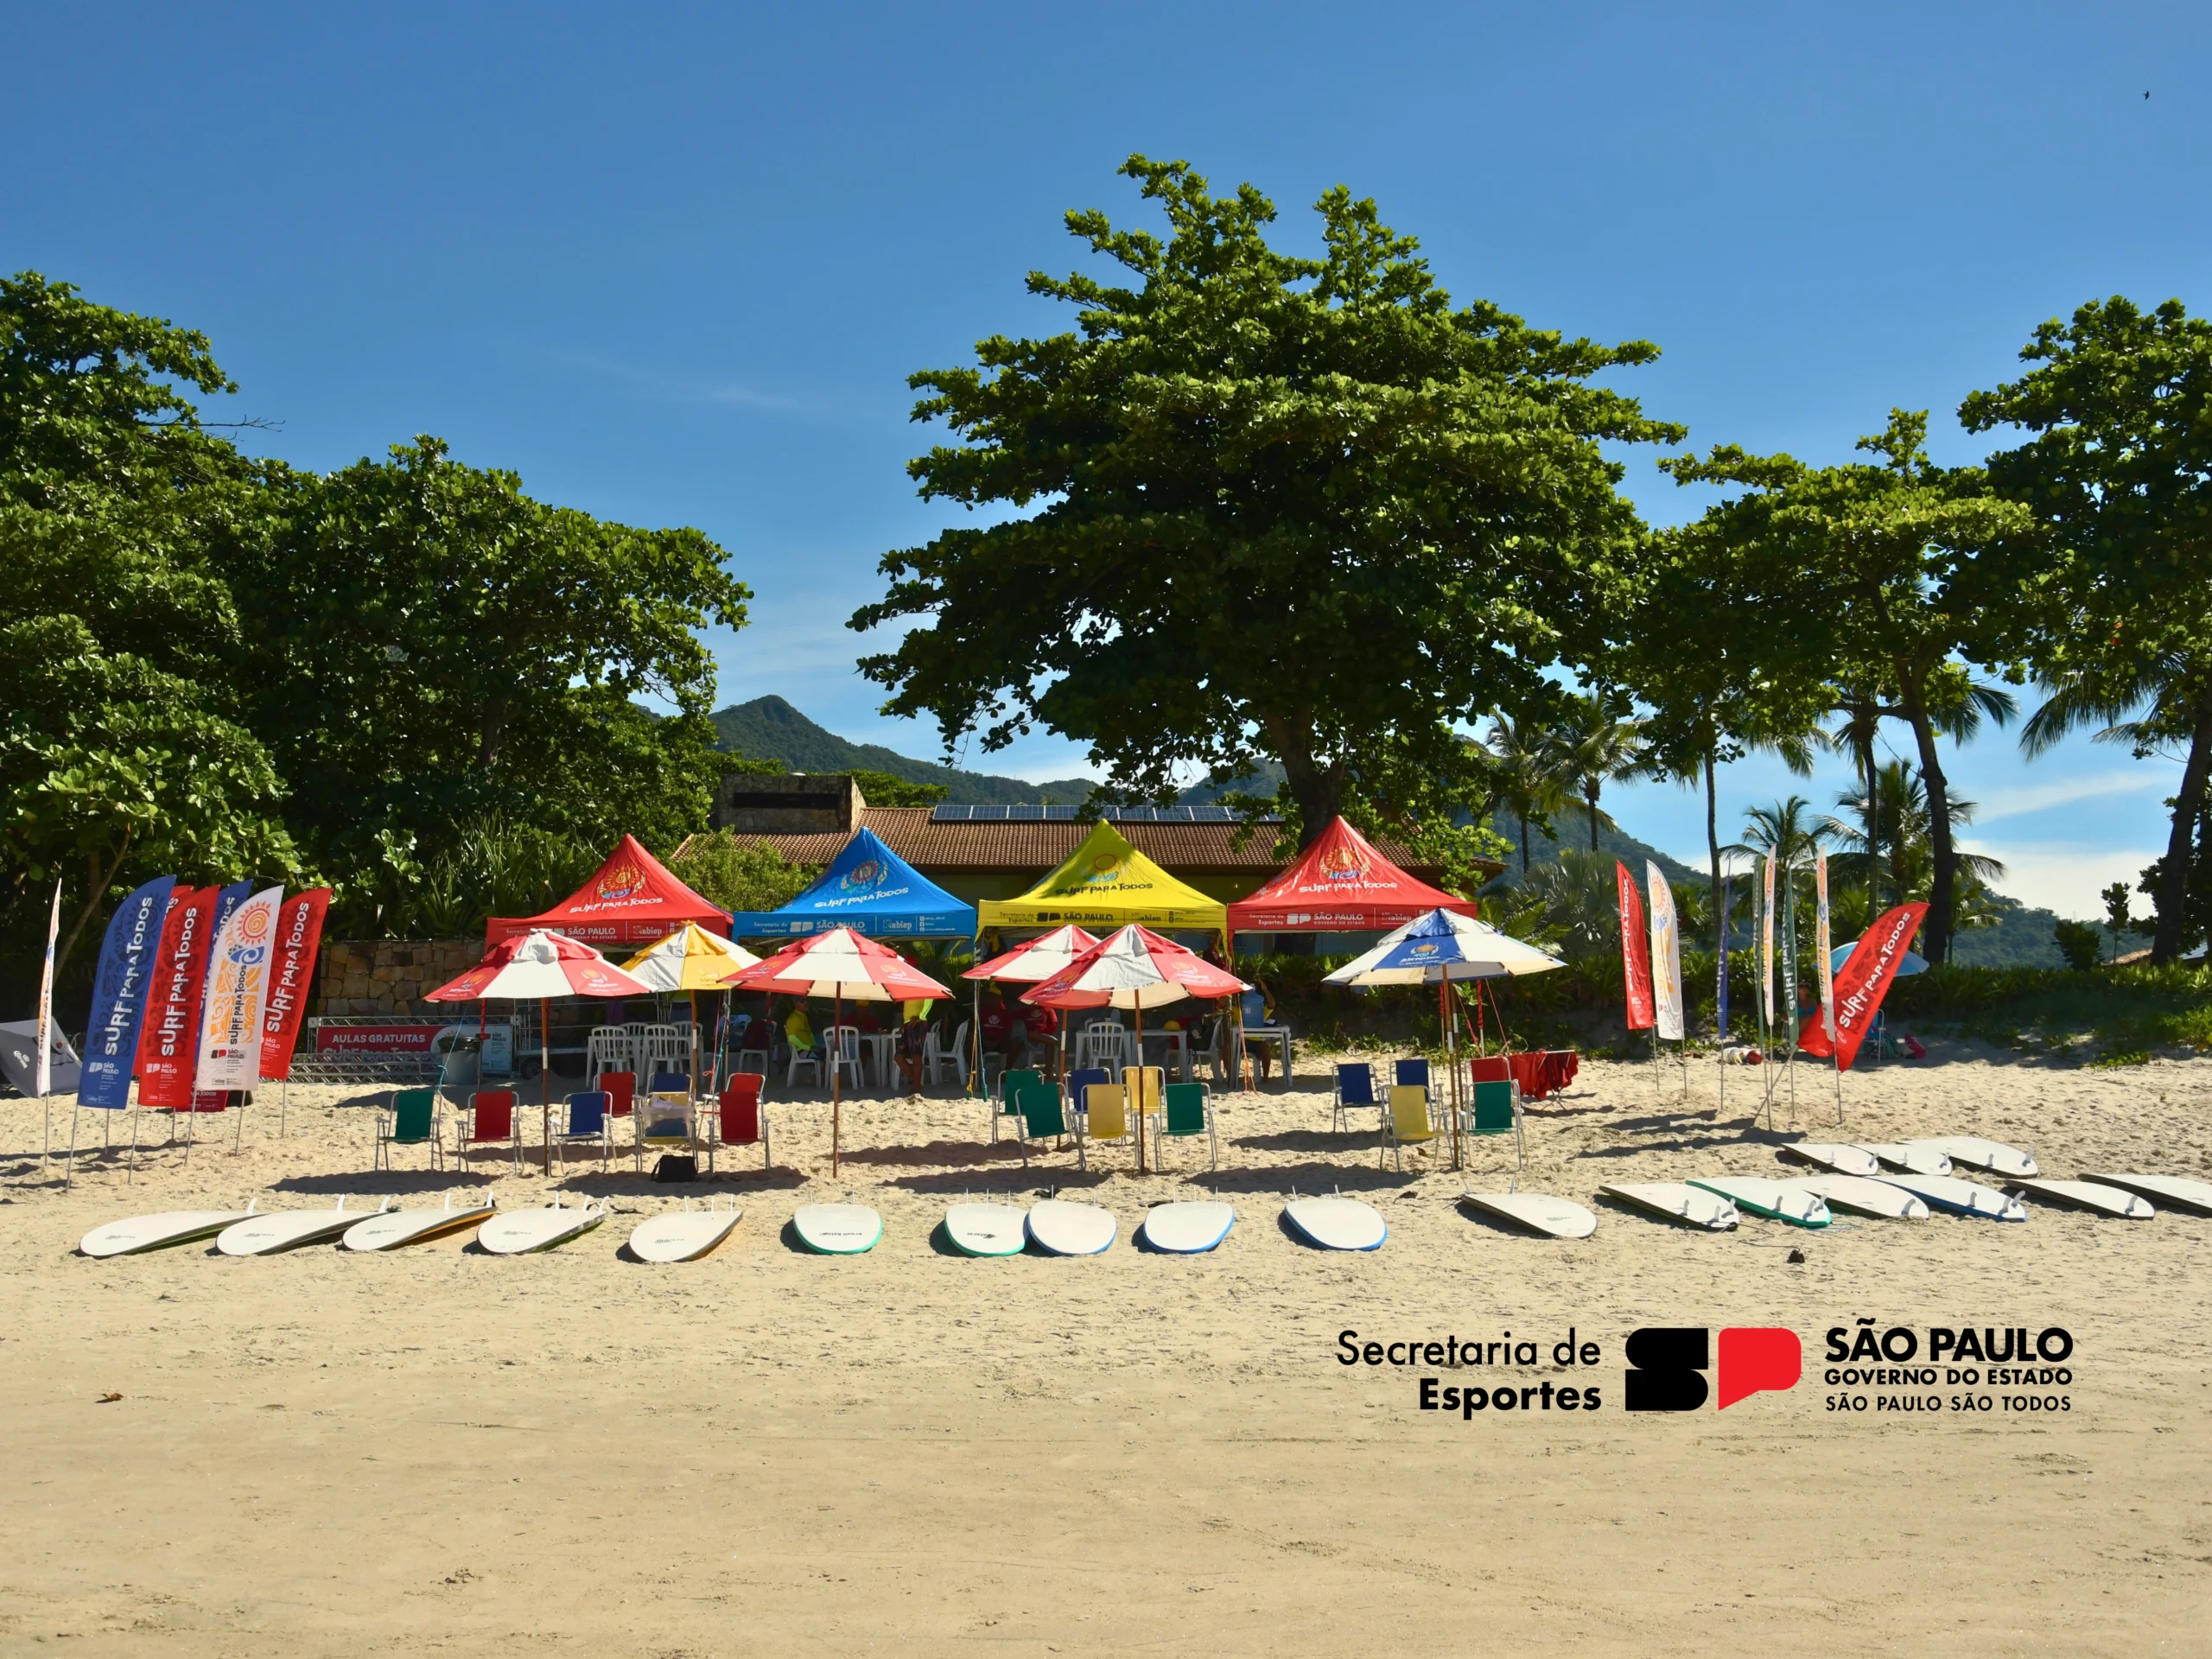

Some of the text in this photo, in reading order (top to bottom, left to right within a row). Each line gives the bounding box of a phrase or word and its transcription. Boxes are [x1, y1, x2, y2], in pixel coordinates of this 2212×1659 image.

[814, 887, 909, 908] SURF PARA TODOS
[1055, 882, 1154, 895] SURF PARA TODOS
[1299, 880, 1398, 893] SURF PARA TODOS
[569, 897, 663, 913] SURF PARA TODOS
[1064, 911, 1083, 920] SÃO
[1313, 912, 1332, 921] SÃO
[126, 896, 153, 954] TODOS
[175, 906, 198, 962] TODOS
[286, 902, 309, 950] TODOS
[567, 925, 616, 936] SÃO PAULO
[816, 919, 835, 930] SÃO
[119, 952, 140, 998] PARA
[169, 959, 187, 1002] PARA
[234, 964, 247, 995] TODOS
[282, 950, 299, 988] PARA
[1840, 912, 1911, 1029] SURF PARA TODOS
[1783, 967, 1796, 1011] SURF
[233, 993, 244, 1017] PARA
[266, 987, 295, 1033] SURF
[104, 1001, 133, 1056] SURF
[158, 1004, 186, 1057] SURF
[227, 1017, 244, 1046] SURF
[332, 1033, 426, 1044] AULAS GRATUITAS
